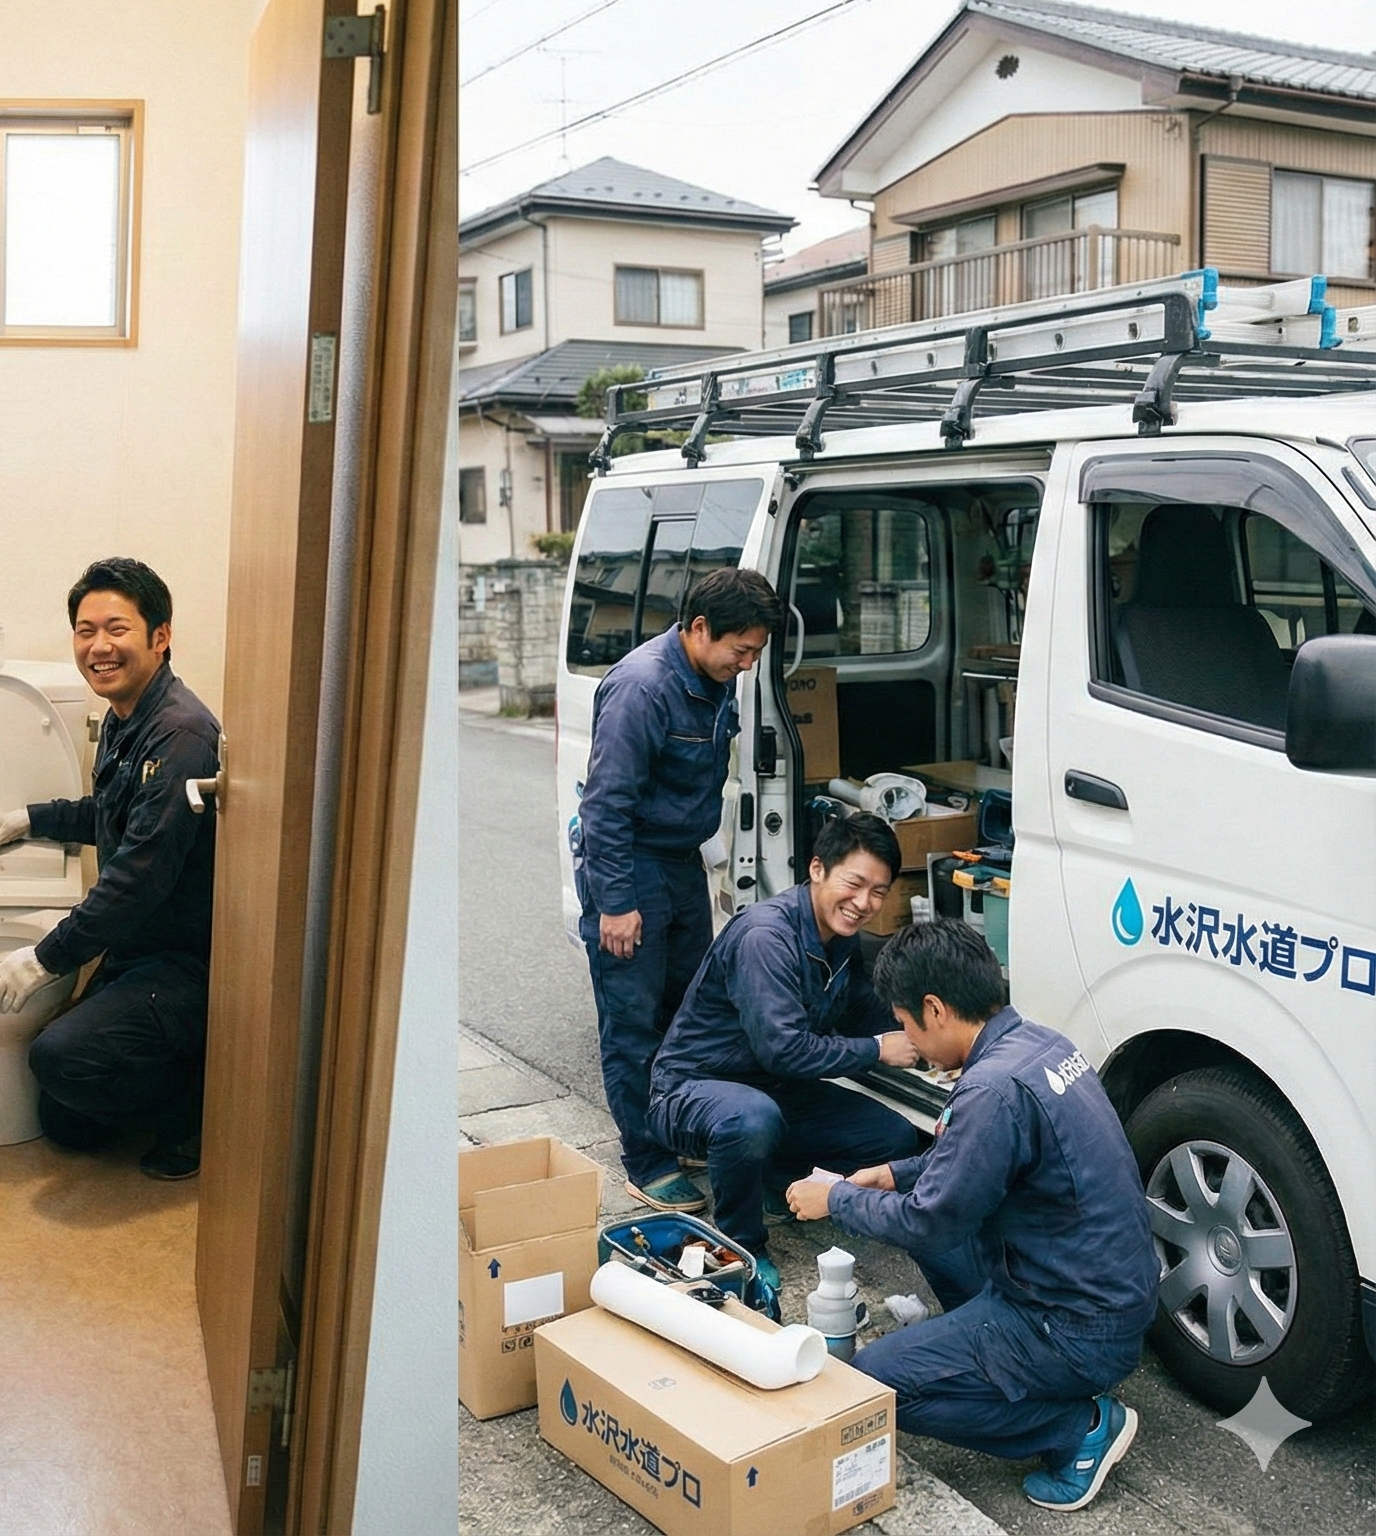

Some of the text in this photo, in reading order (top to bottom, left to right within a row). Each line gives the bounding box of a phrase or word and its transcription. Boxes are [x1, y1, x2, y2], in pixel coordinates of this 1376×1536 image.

[1151, 896, 1376, 996] 水沢水道プロ
[581, 1400, 701, 1509] 水沢水道プロ
